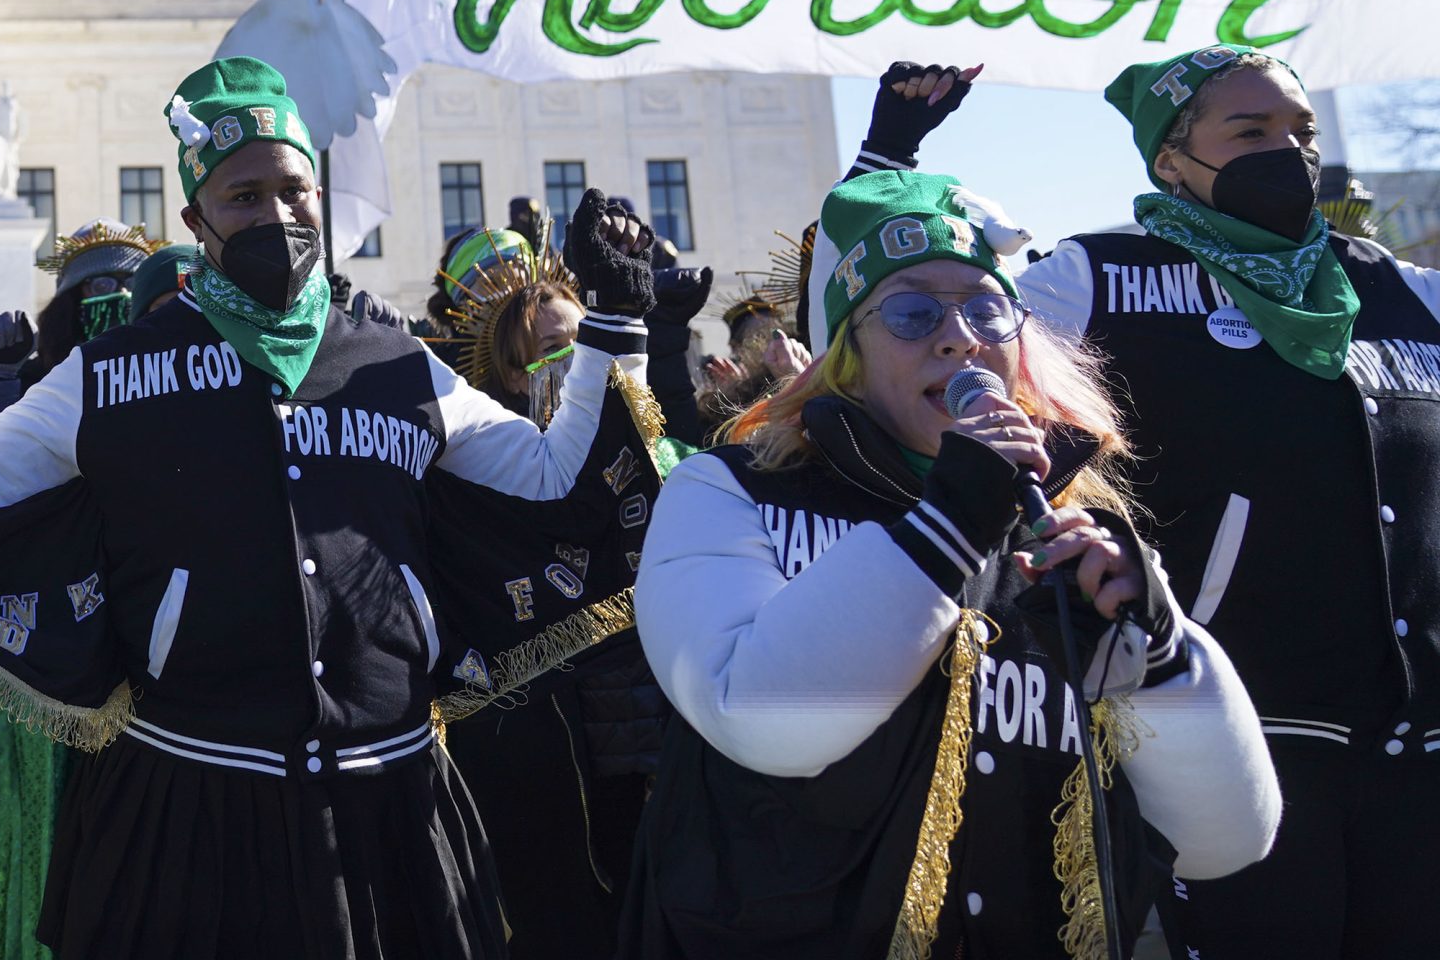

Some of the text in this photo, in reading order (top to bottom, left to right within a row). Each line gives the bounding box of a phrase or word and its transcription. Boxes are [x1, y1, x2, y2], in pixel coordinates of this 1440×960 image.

[1101, 262, 1209, 315] THANK
[1221, 327, 1248, 339] PILLS
[92, 340, 242, 409] THANK GOD
[278, 404, 331, 456] FOR
[977, 652, 1048, 749] FOR
